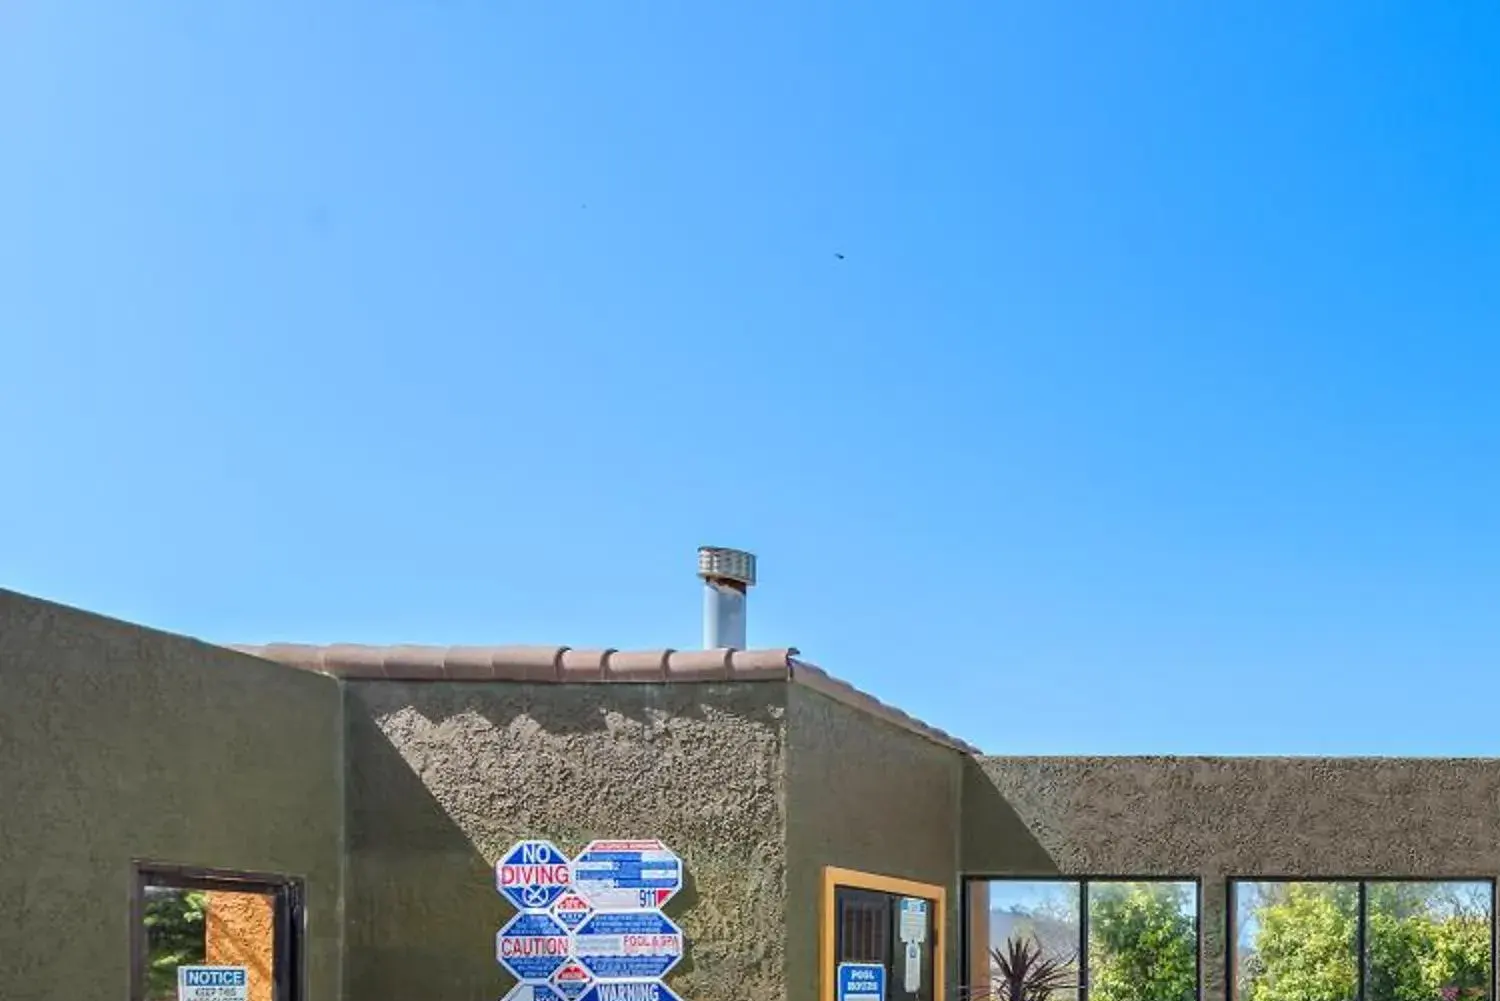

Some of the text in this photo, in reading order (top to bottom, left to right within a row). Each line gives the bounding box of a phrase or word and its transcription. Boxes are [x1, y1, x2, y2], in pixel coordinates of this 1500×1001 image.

[523, 843, 551, 863] NO
[501, 866, 570, 884] DIVING
[640, 889, 656, 908] 911
[502, 938, 568, 955] CAUTION
[188, 971, 243, 985] NOTICE
